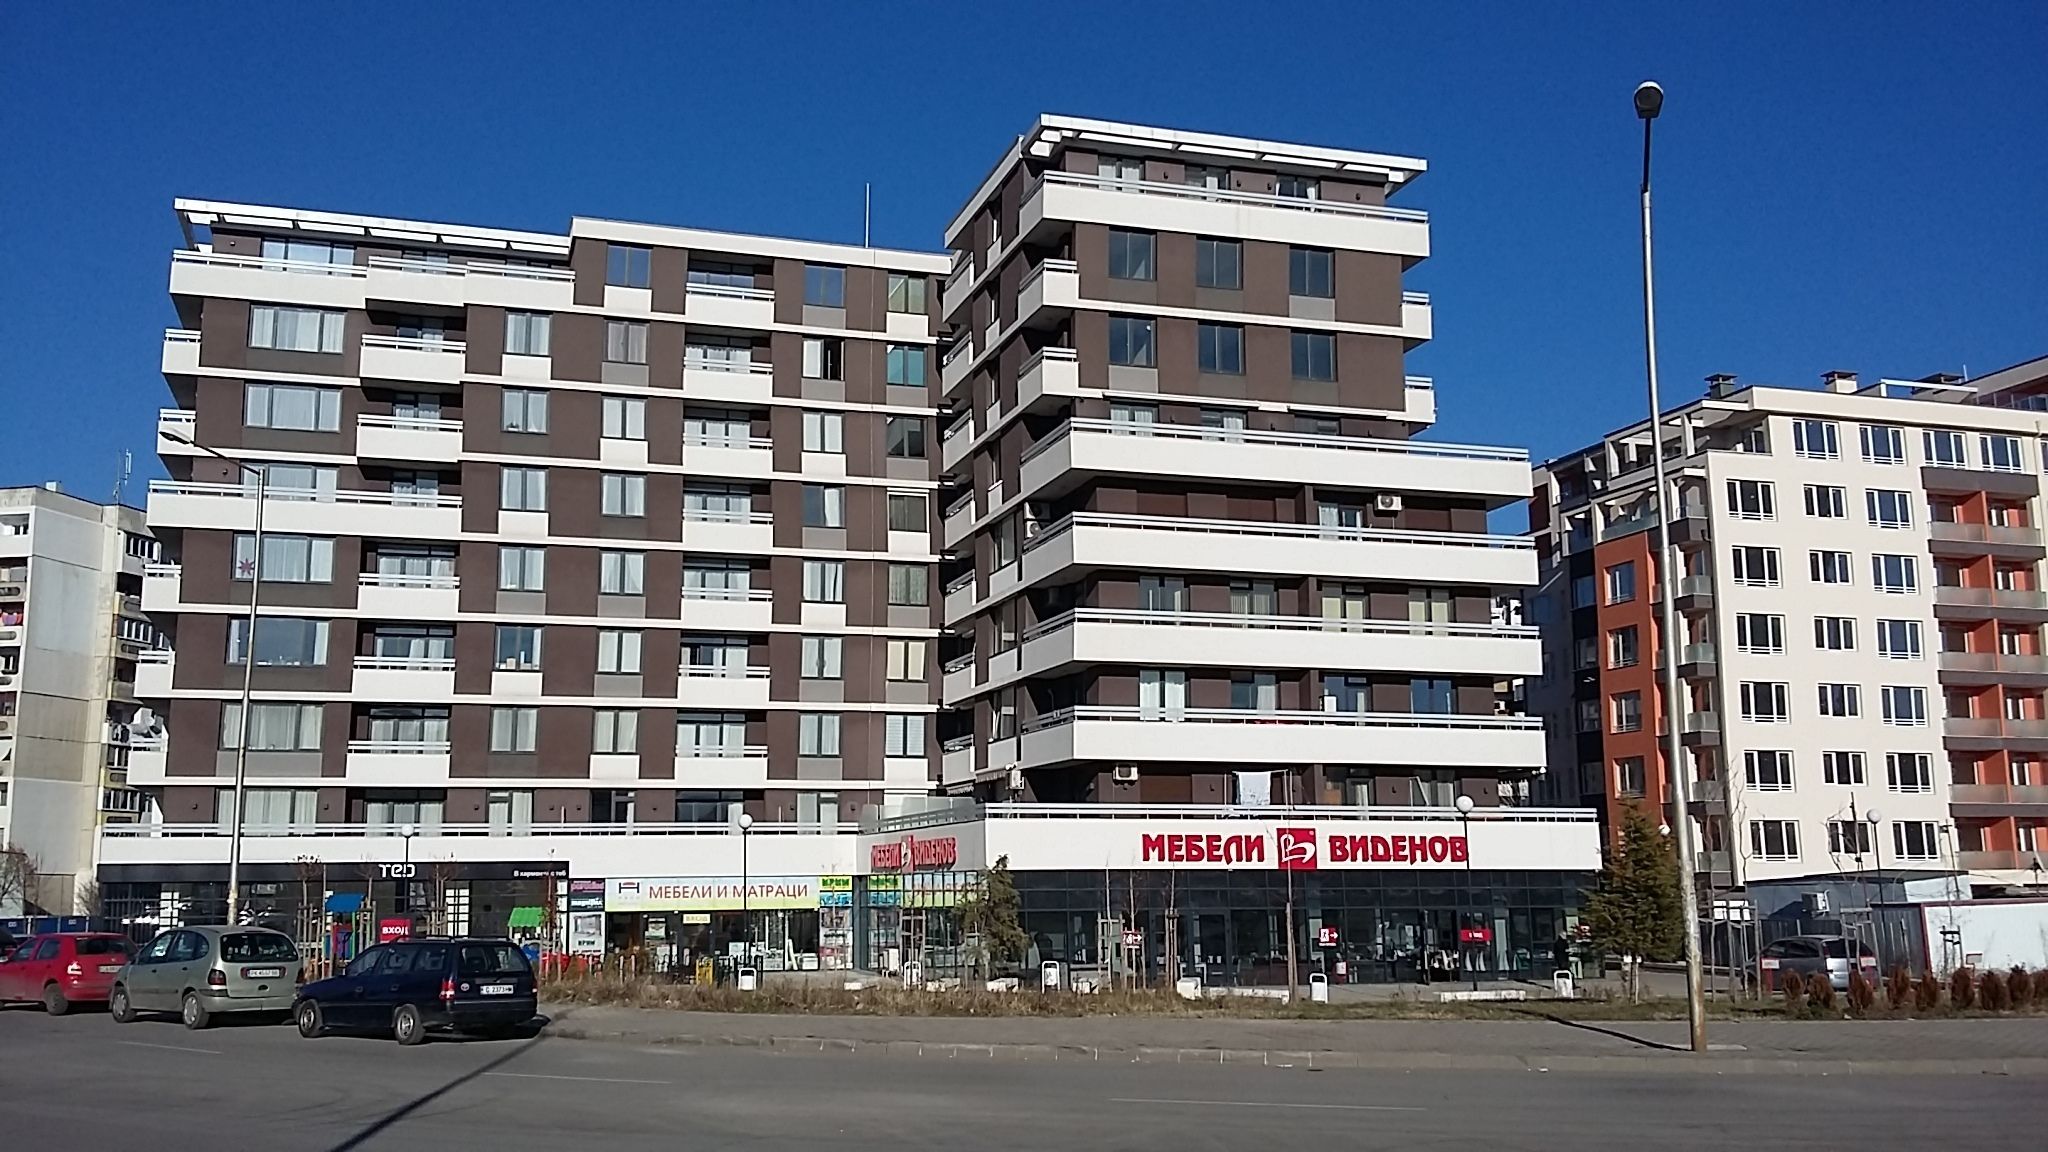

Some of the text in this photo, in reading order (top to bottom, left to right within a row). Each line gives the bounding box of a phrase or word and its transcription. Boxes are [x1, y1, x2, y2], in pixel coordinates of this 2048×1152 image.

[871, 842, 902, 869] МЕБЕЛИ
[913, 837, 957, 868] ВИДЕНОВ
[1142, 834, 1265, 865] МЕБЕЛИ
[1328, 835, 1469, 865] ВИДЕНОВ
[649, 884, 808, 899] МЕБЕЛИ И МАТРАЦИ
